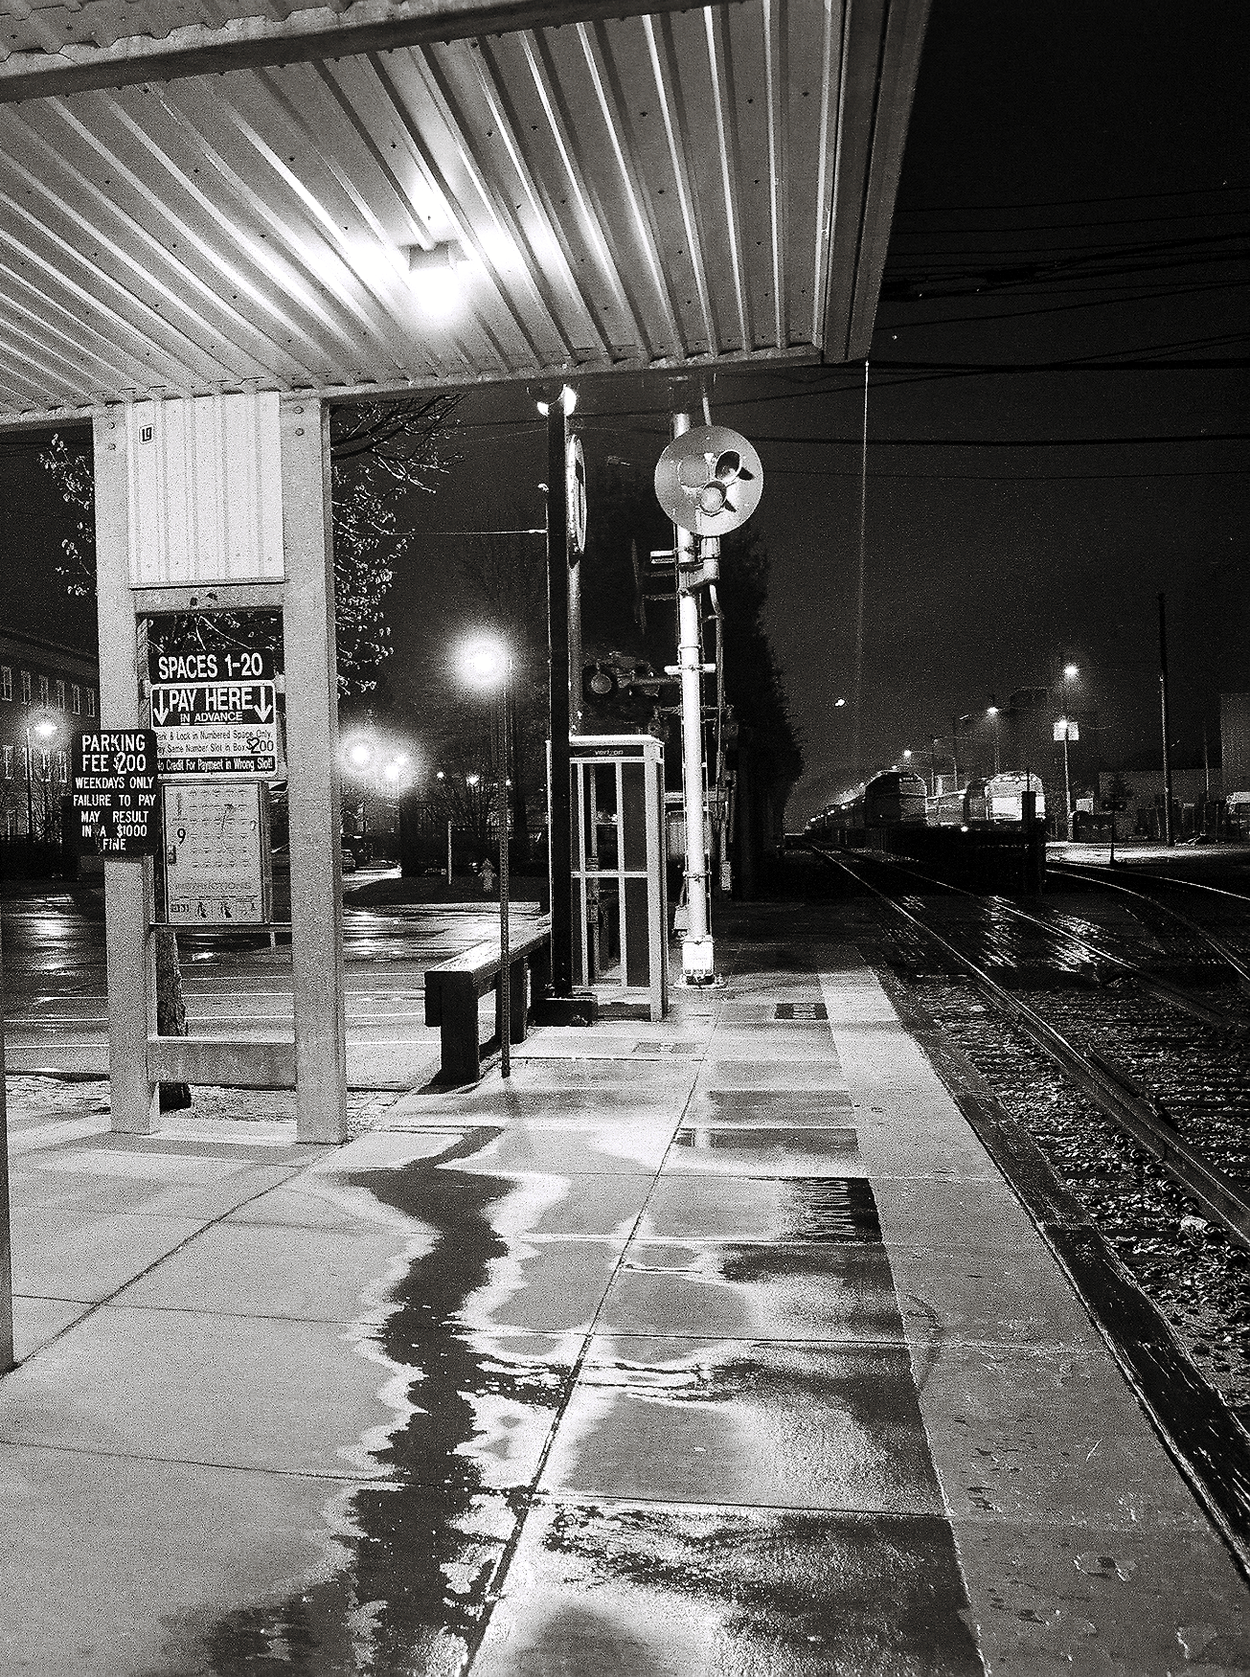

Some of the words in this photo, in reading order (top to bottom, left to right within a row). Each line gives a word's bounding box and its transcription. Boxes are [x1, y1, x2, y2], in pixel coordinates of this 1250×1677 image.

[158, 654, 218, 680] SPACES
[224, 652, 263, 677] 1-20
[169, 689, 197, 712] PAY
[205, 687, 253, 711] HERE
[180, 713, 190, 723] IN
[194, 711, 243, 722] ADVANCE
[200, 730, 231, 740] Numbered
[81, 734, 146, 752] PARKING
[82, 754, 109, 772] FEE
[112, 752, 147, 774] $200
[166, 759, 184, 771] Credit
[186, 759, 196, 771] For
[197, 758, 224, 773] Payment
[225, 758, 232, 770] in
[233, 758, 255, 772] Wrong
[75, 777, 125, 789] WEEKDAYS
[129, 776, 154, 789] ONLY
[73, 794, 112, 807] FAILURE
[118, 794, 131, 807] TO
[138, 794, 156, 806] PAY
[81, 810, 101, 823] MAY
[112, 810, 149, 823] RESULT
[81, 825, 92, 837] IN
[99, 825, 107, 837] A
[116, 823, 148, 838] $1000
[177, 828, 186, 845] 9
[102, 838, 127, 851] FINE
